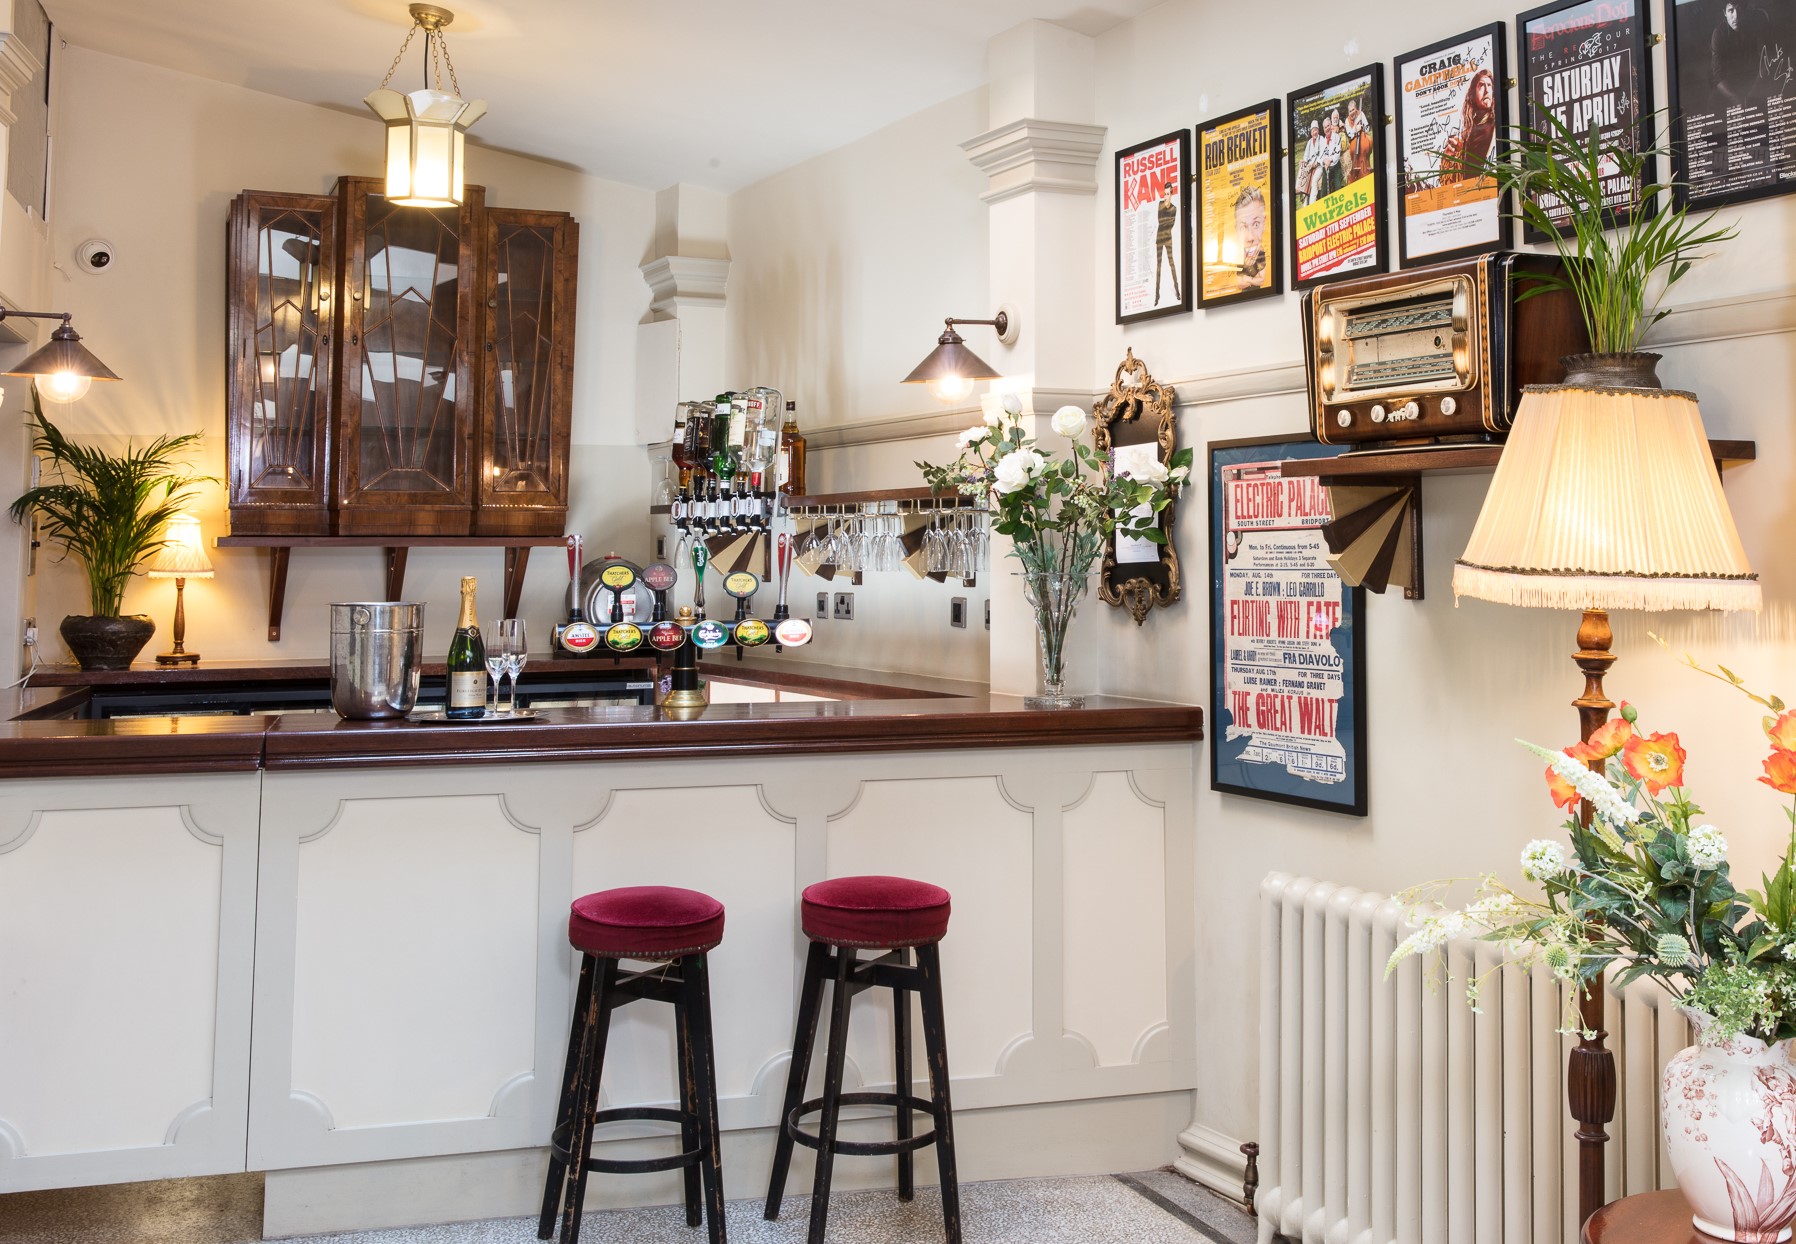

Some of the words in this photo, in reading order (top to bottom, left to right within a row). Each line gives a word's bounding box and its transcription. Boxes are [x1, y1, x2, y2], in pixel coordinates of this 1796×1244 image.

[1420, 54, 1461, 76] CRAIG
[1532, 52, 1552, 63] THE
[1545, 54, 1582, 70] SPRING
[1416, 88, 1432, 98] DON'T
[1433, 84, 1448, 92] LOOK
[1543, 56, 1621, 108] SATURDAY
[1550, 106, 1566, 138] 15
[1572, 92, 1618, 134] APRIL
[1124, 148, 1177, 178] RUSSELL
[1205, 139, 1224, 170] ROB
[1227, 125, 1267, 164] BECKETT
[1124, 164, 1178, 212] KANE
[1324, 193, 1345, 209] The
[1298, 227, 1326, 249] SATURDAY
[1326, 221, 1339, 236] 17TH
[1339, 206, 1372, 230] SEPTEMBER
[1303, 192, 1368, 231] Wurzels
[1298, 240, 1327, 264] BRIDPORT
[1327, 227, 1353, 250] ELECTRIC
[1353, 217, 1375, 239] PALACE
[1235, 482, 1283, 520] ELECTRIC
[1288, 479, 1331, 517] PALACE
[1244, 581, 1254, 596] JOE
[1262, 582, 1280, 597] BROWN
[1286, 582, 1296, 597] LEO
[1231, 600, 1270, 637] FLIRTING
[1276, 600, 1299, 638] WITH
[1306, 601, 1339, 640] FATE
[1283, 652, 1296, 664] FRA
[1298, 654, 1340, 667] DIAVOLO
[1244, 676, 1257, 685] LUISE
[1260, 678, 1277, 686] RAINER
[1282, 679, 1304, 689] FERNAND
[1307, 681, 1326, 690] GRAVET
[1232, 690, 1252, 728] THE
[1256, 693, 1293, 733] GREAT
[1298, 696, 1338, 737] WALT
